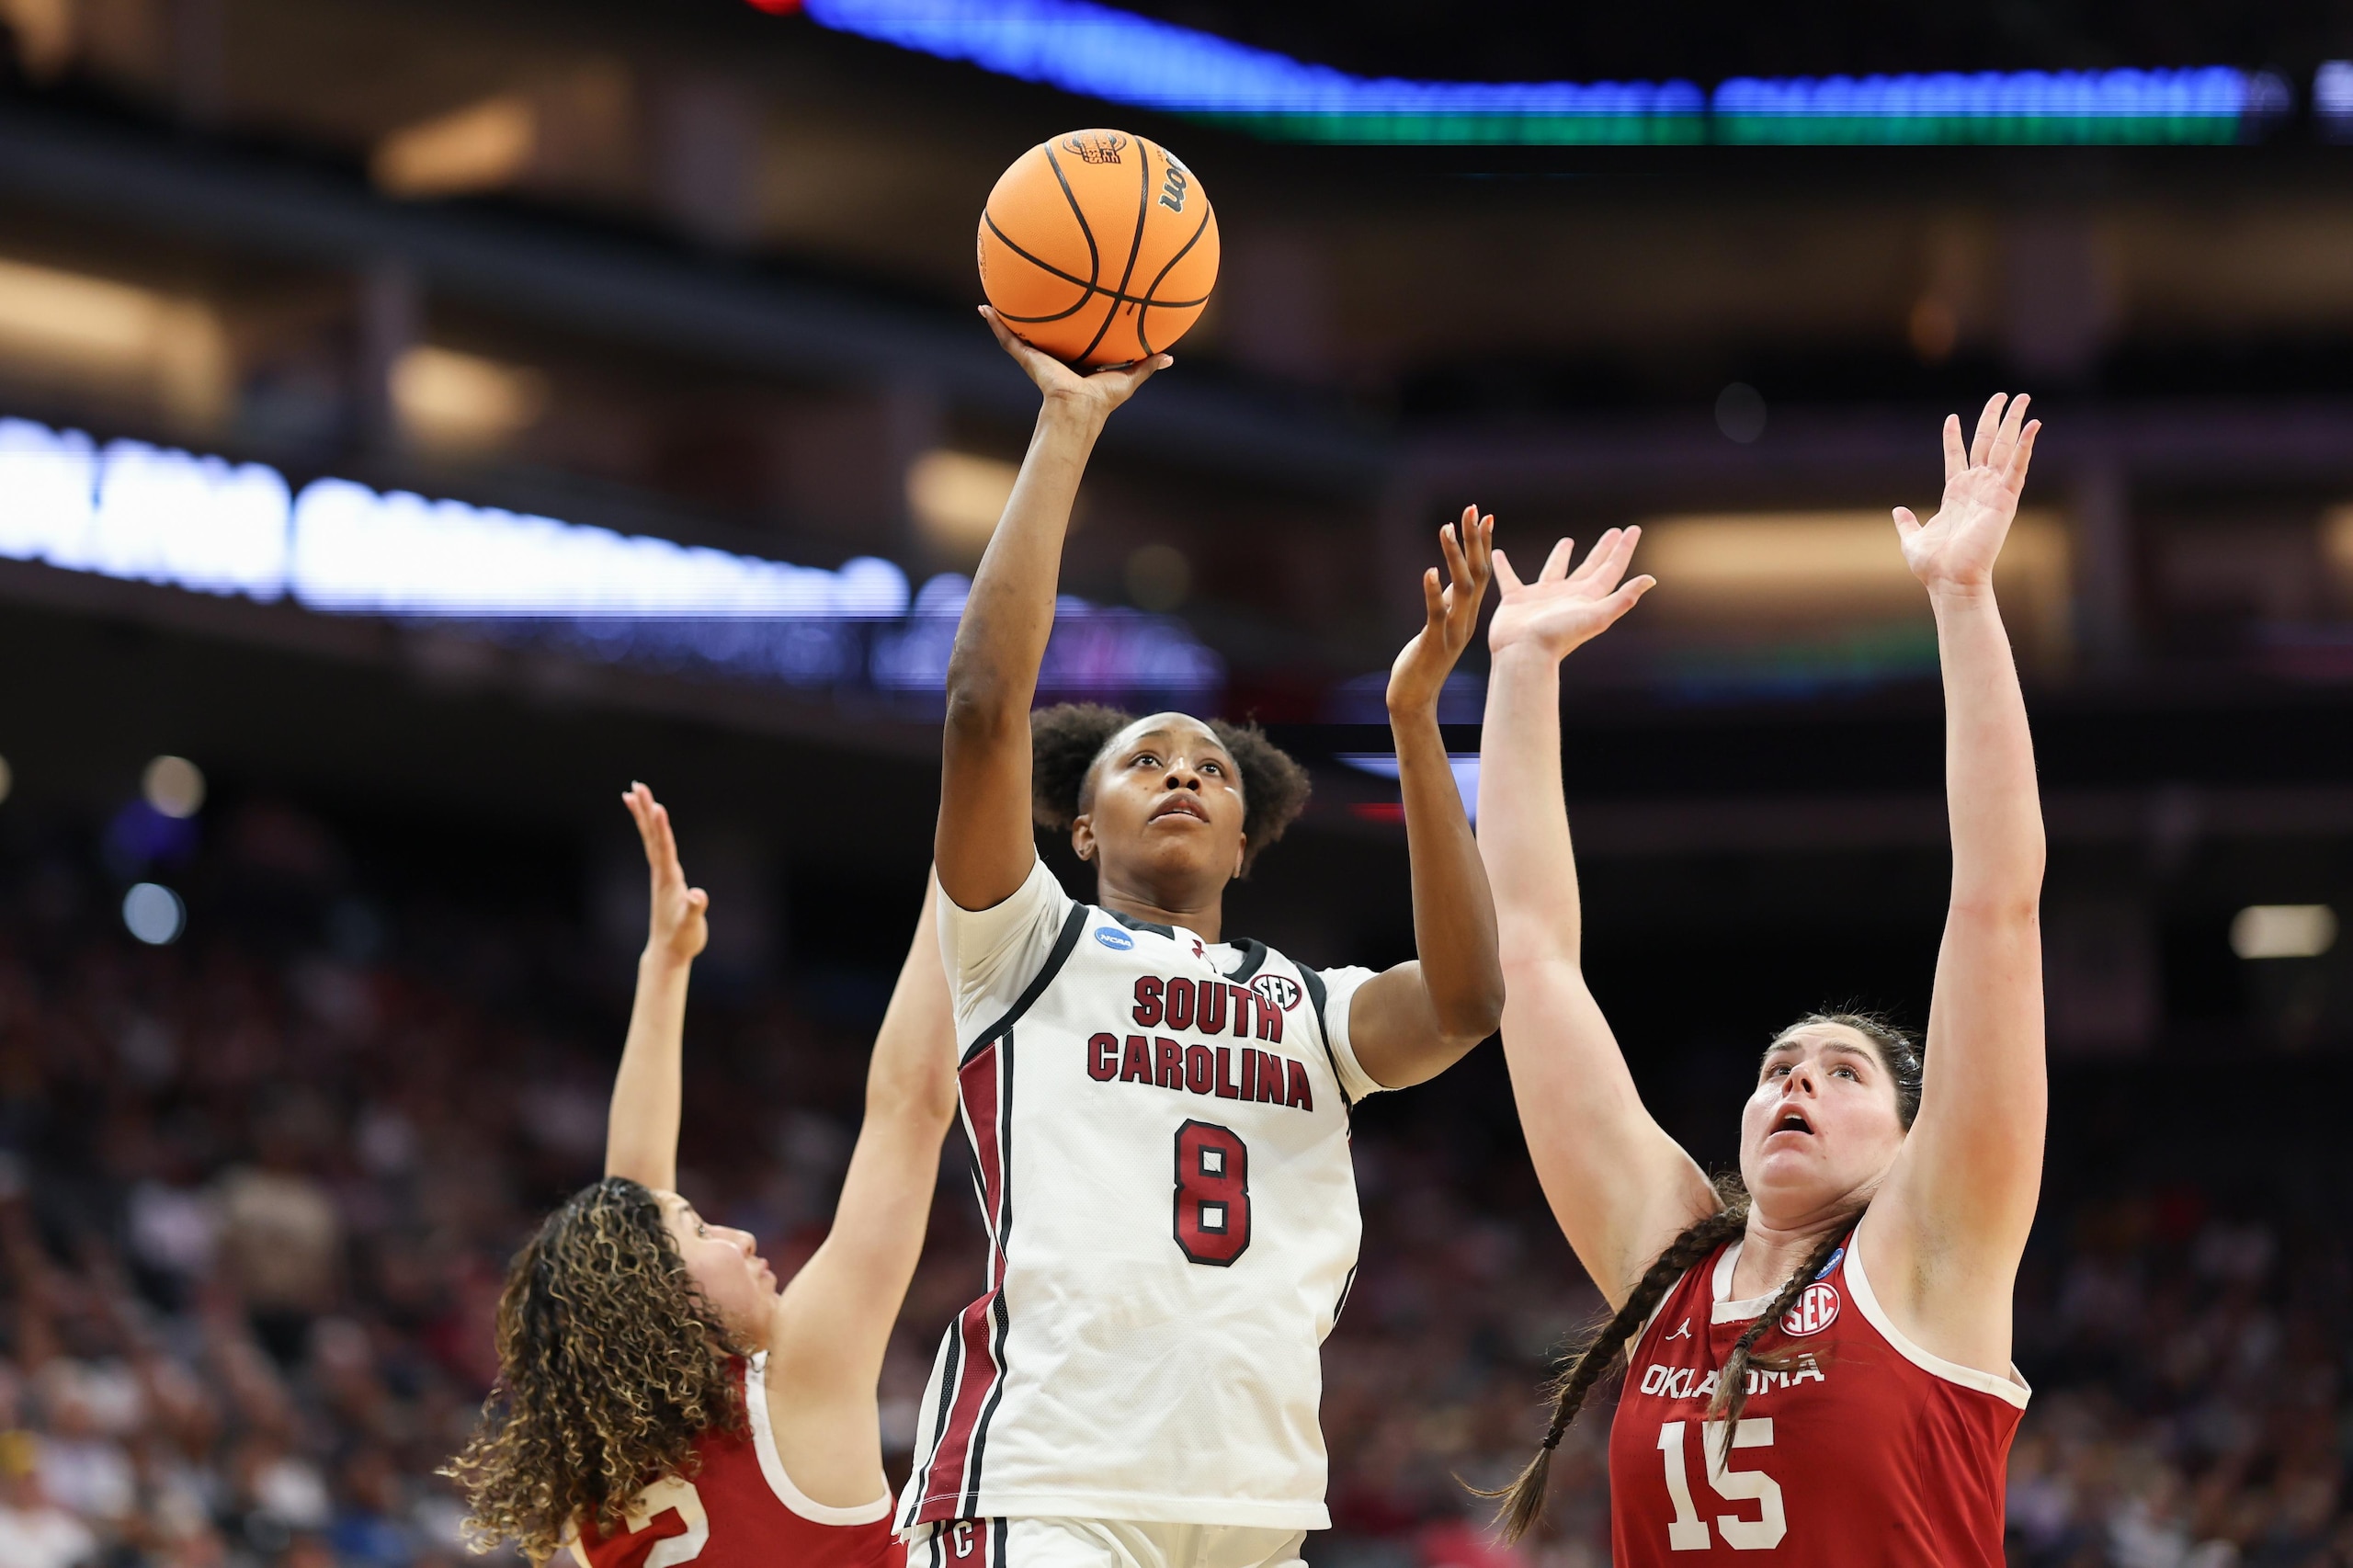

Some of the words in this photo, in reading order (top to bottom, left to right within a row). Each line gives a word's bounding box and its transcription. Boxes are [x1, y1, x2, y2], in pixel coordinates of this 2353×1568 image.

[1100, 934, 1131, 948] NCAA
[1132, 975, 1285, 1044] SOUTH
[1253, 974, 1299, 1010] SEC
[1087, 1032, 1313, 1112] CAROLINA
[1173, 1118, 1252, 1267] 8
[1786, 1286, 1835, 1333] SEC
[1640, 1352, 1825, 1399] OKLAOMA
[1656, 1416, 1788, 1551] 15
[952, 1519, 974, 1560] C
